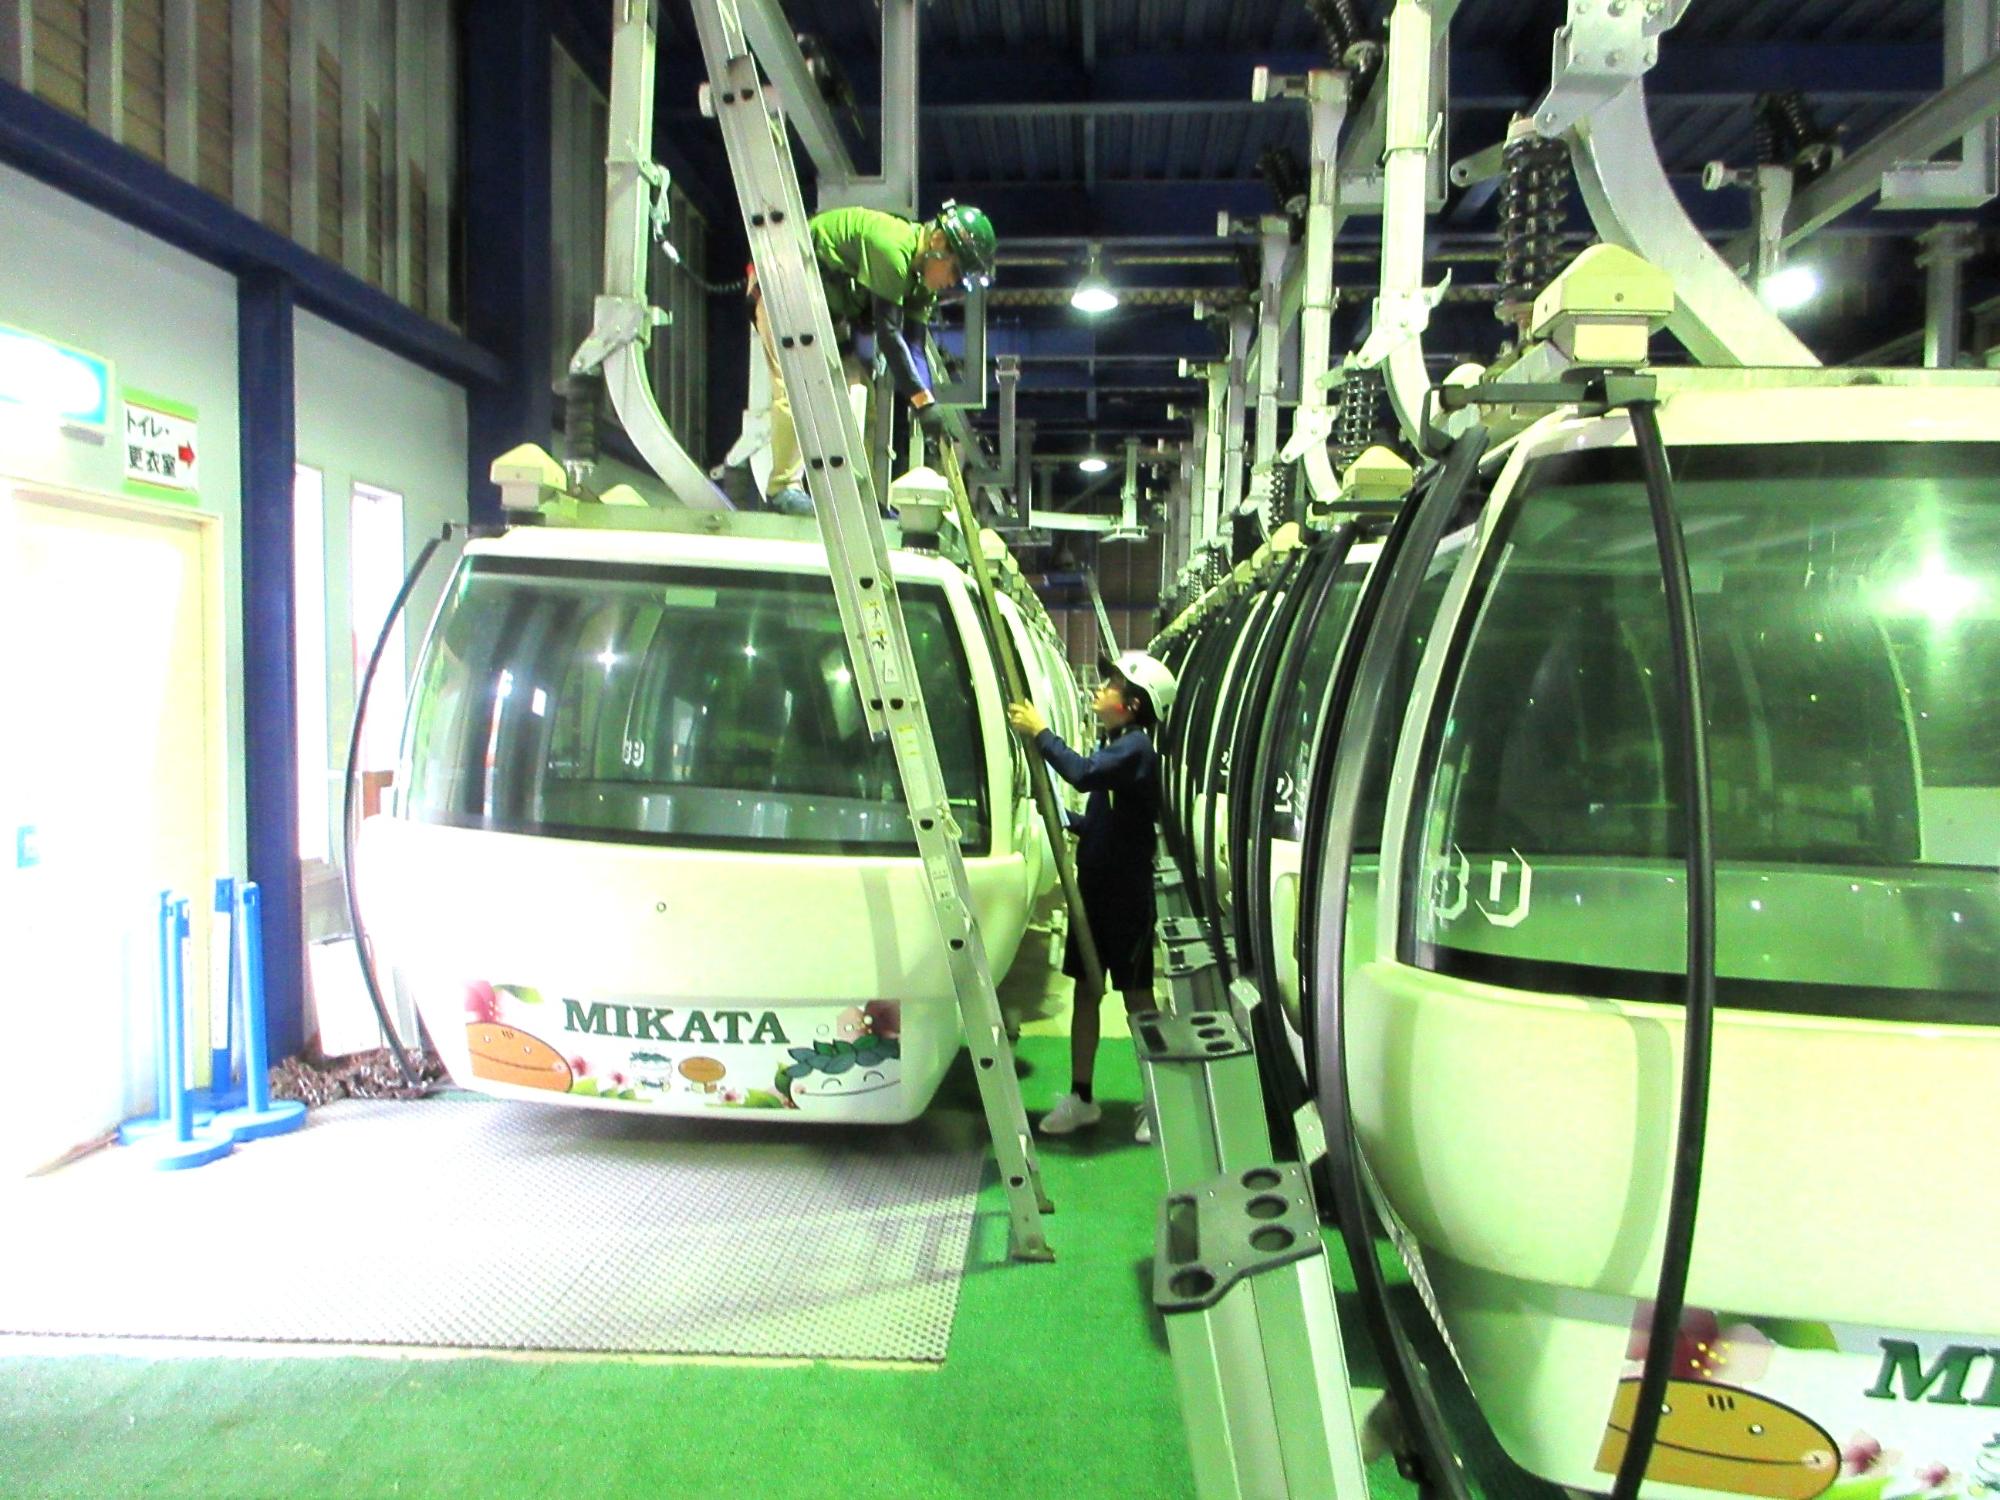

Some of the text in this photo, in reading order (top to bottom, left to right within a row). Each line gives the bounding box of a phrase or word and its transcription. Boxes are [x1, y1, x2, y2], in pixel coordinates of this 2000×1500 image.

[128, 444, 177, 478] 更衣室
[562, 998, 791, 1045] MIKATA
